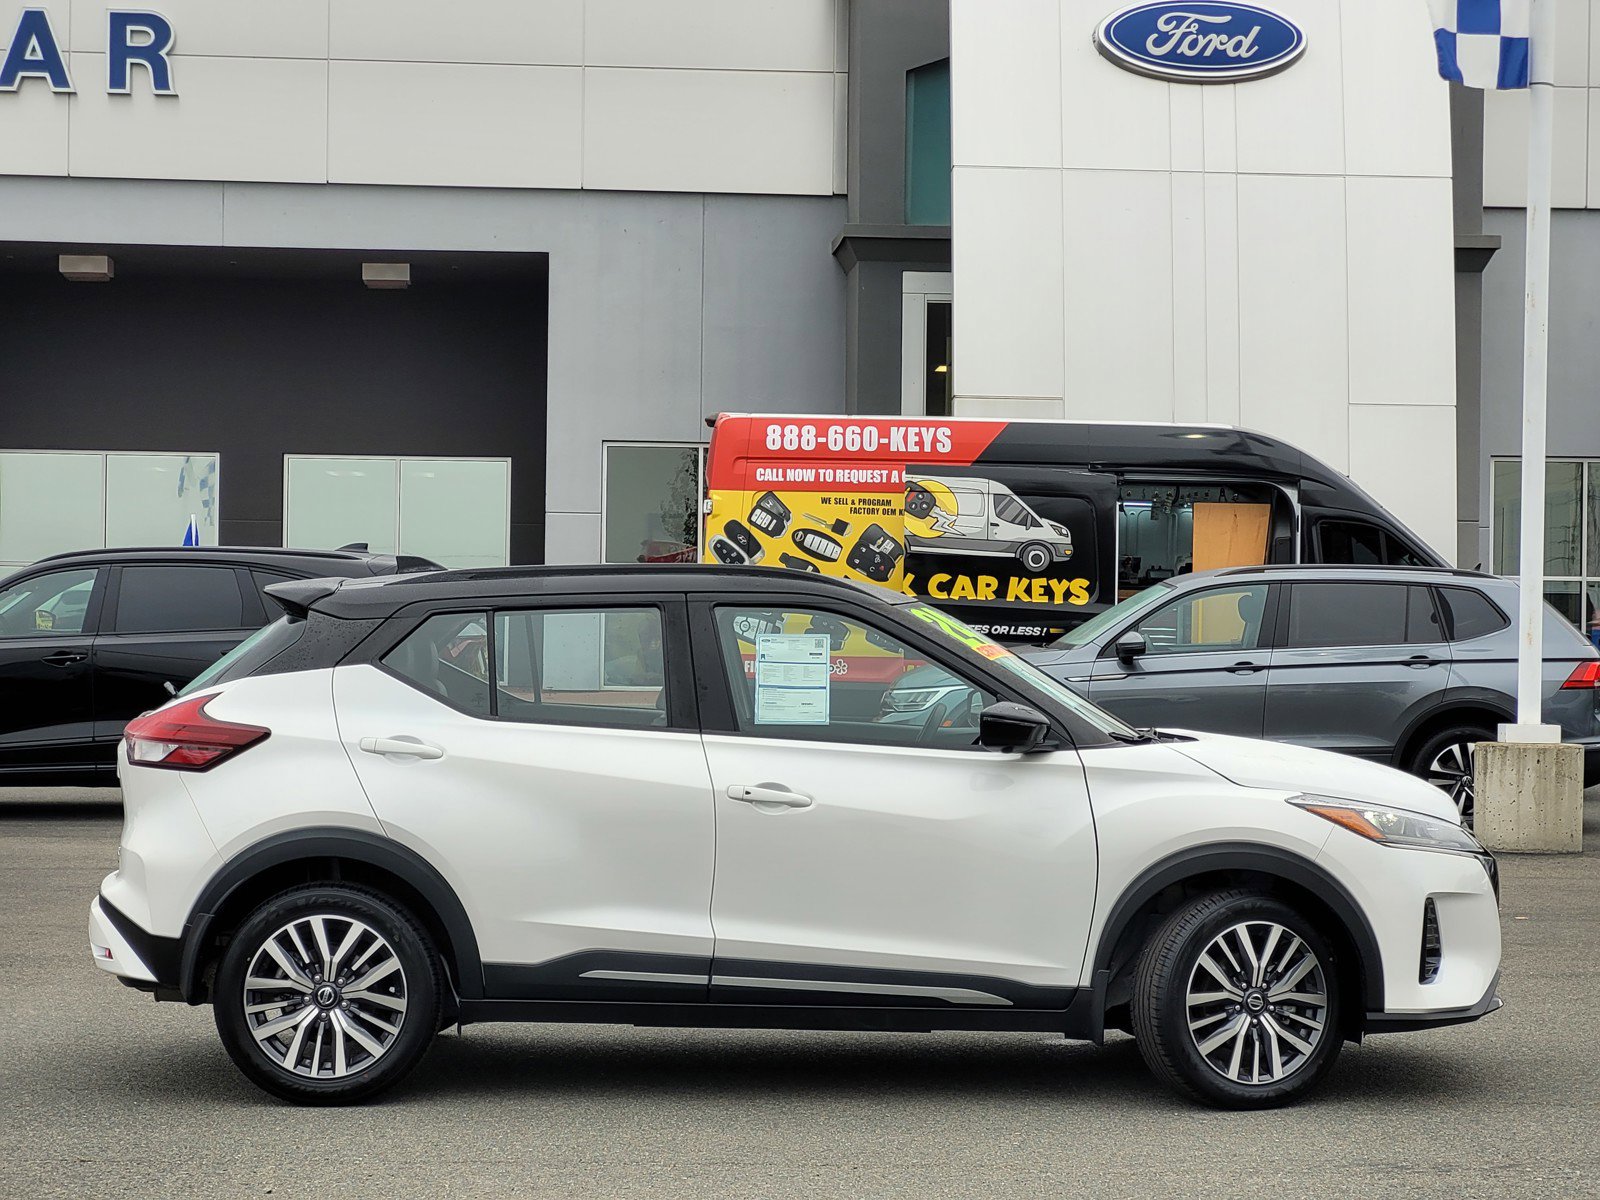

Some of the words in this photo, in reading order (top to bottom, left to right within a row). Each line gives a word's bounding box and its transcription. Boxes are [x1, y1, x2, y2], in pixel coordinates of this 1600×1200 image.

[1146, 11, 1262, 58] Ford
[765, 424, 952, 453] 888-660-KEYS
[756, 468, 784, 482] CALL
[786, 468, 816, 482] NOW
[818, 469, 834, 482] TO
[836, 469, 889, 484] REQUEST
[890, 470, 900, 483] A
[820, 497, 832, 505] WE
[834, 497, 849, 505] SELL
[858, 498, 892, 506] PROGRAM
[849, 507, 880, 515] FACTORY
[882, 508, 896, 516] OEM
[927, 573, 999, 601] CAR
[1006, 576, 1090, 605] KEYS
[991, 625, 1009, 634] OR
